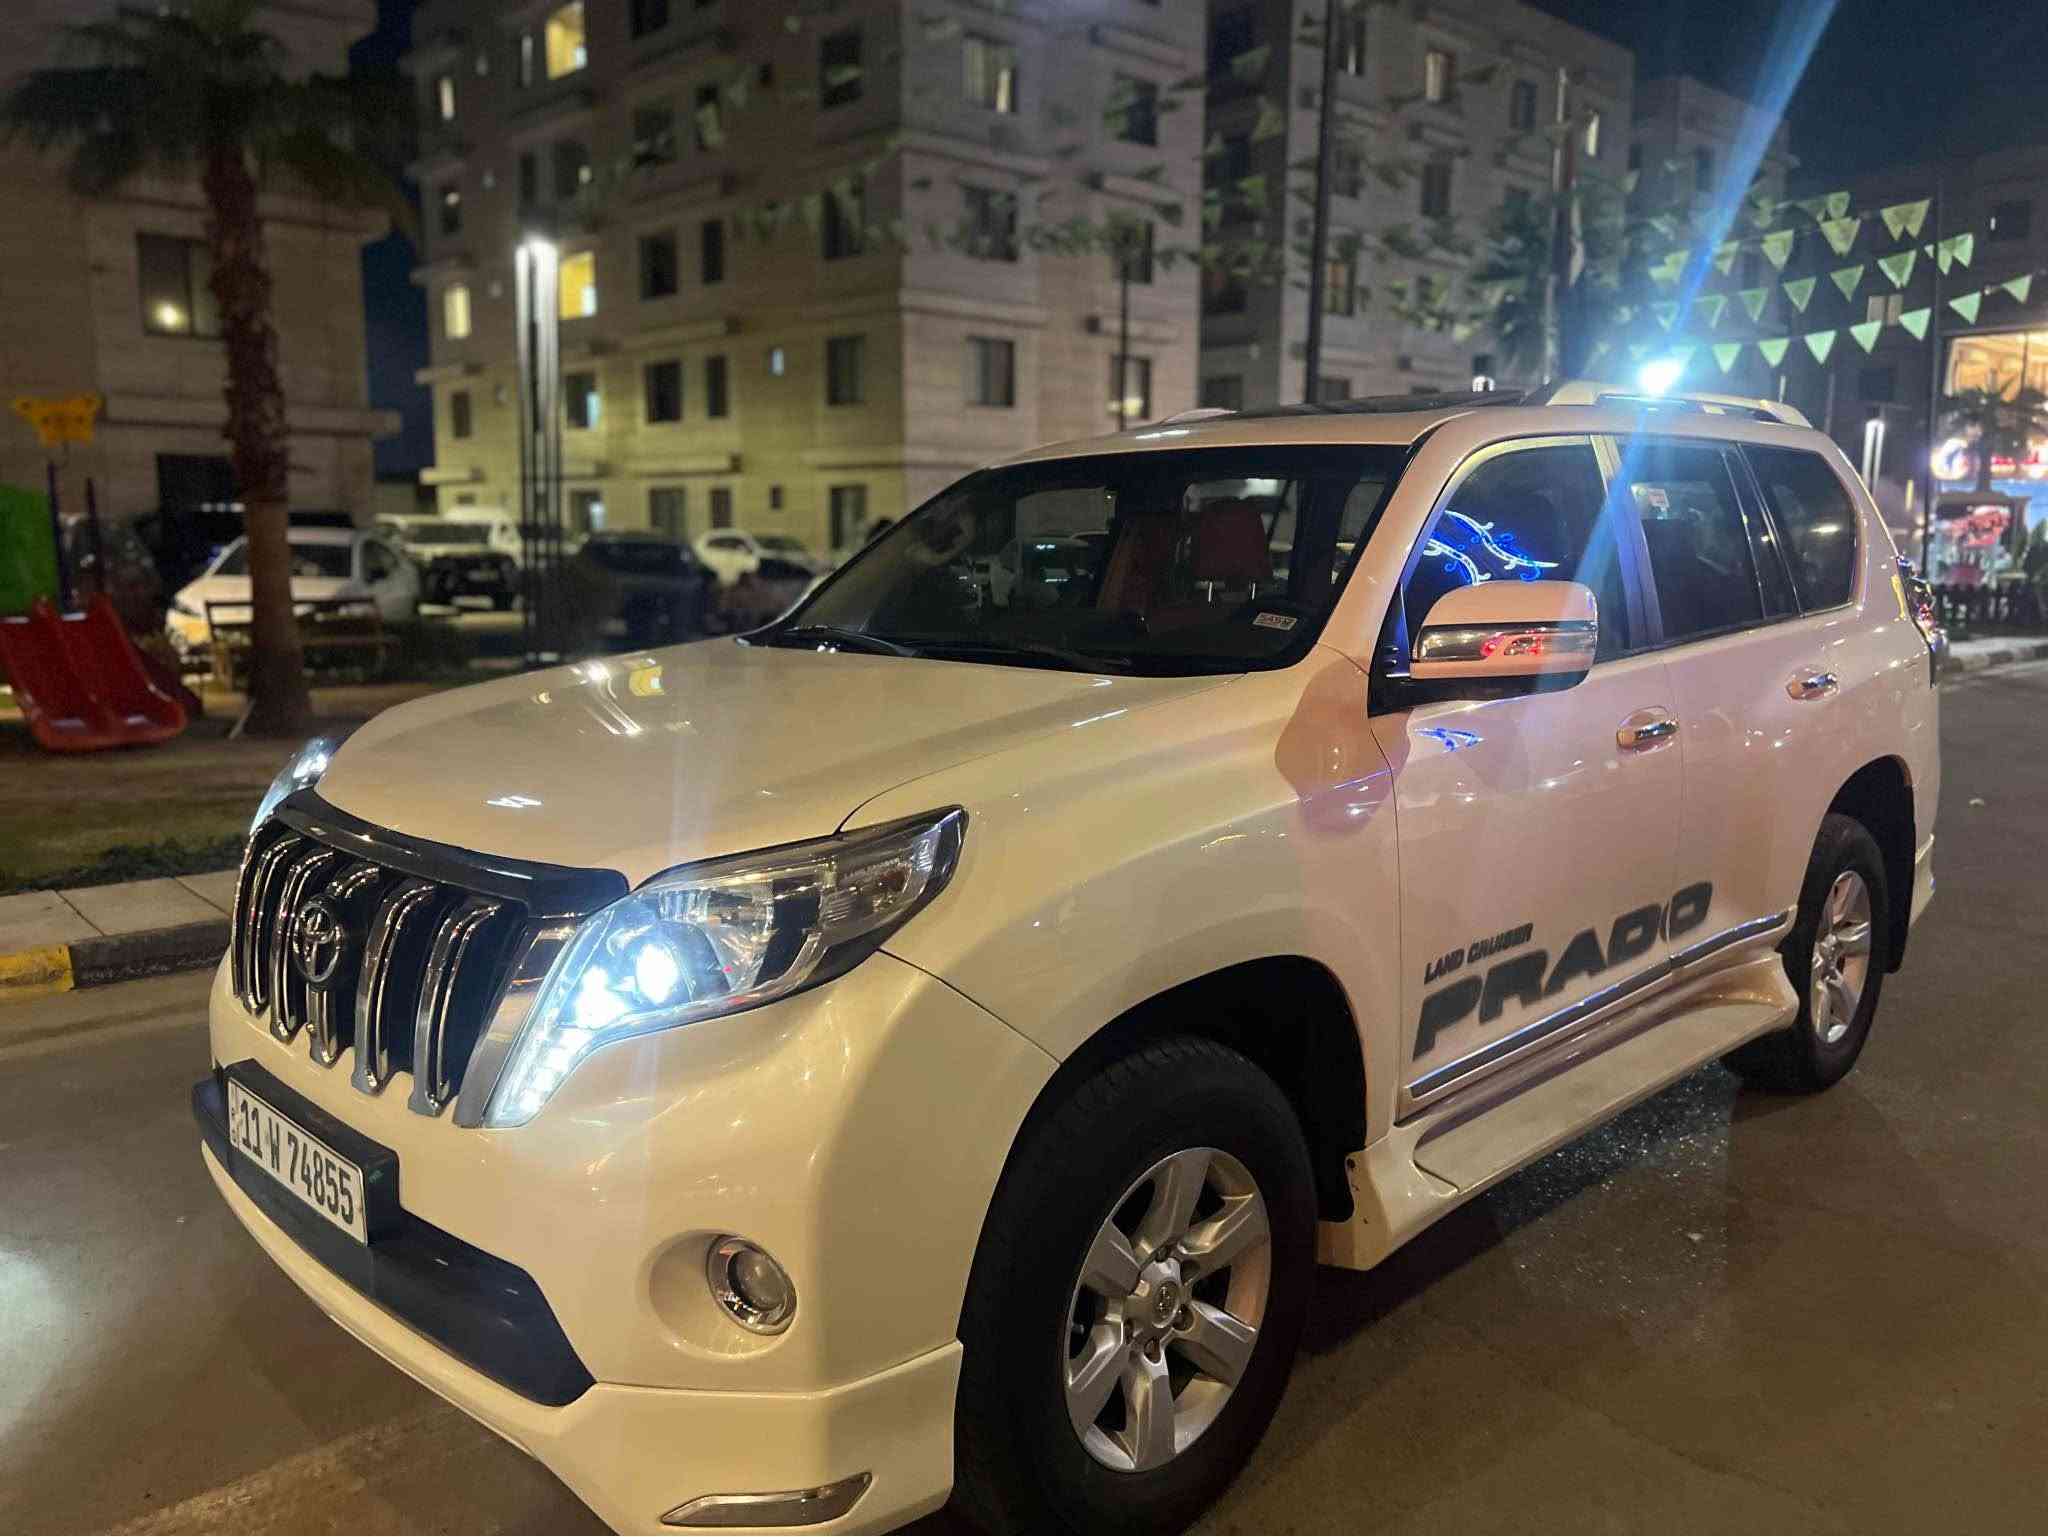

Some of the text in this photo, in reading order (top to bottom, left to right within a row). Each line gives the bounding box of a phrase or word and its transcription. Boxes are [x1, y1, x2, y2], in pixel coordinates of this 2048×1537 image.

[1413, 881, 1713, 1062] PRADO
[1424, 948, 1465, 985] LAND
[241, 1099, 263, 1159] 11
[288, 1131, 354, 1225] 74855
